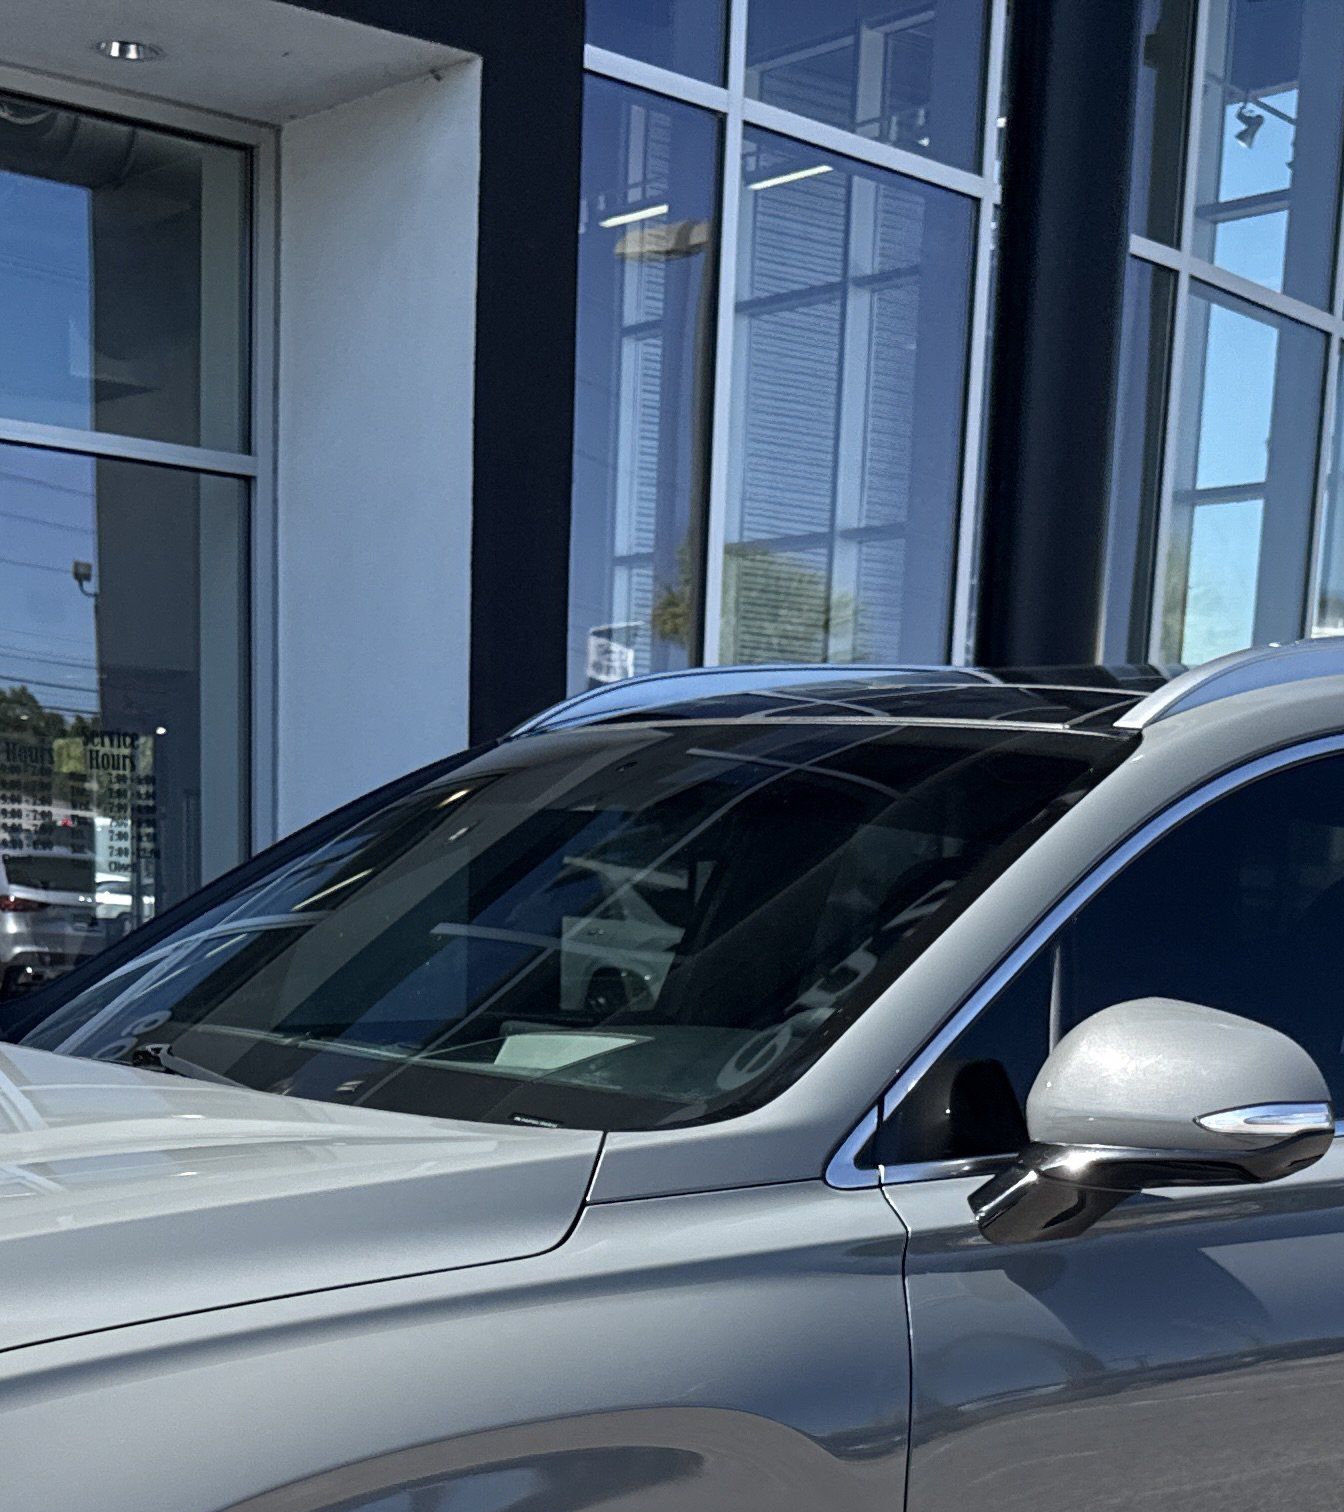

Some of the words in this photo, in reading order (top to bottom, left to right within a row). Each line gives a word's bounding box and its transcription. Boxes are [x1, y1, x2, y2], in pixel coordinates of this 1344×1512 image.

[80, 727, 139, 750] Service
[5, 740, 56, 765] Hours
[88, 749, 137, 772] Hours
